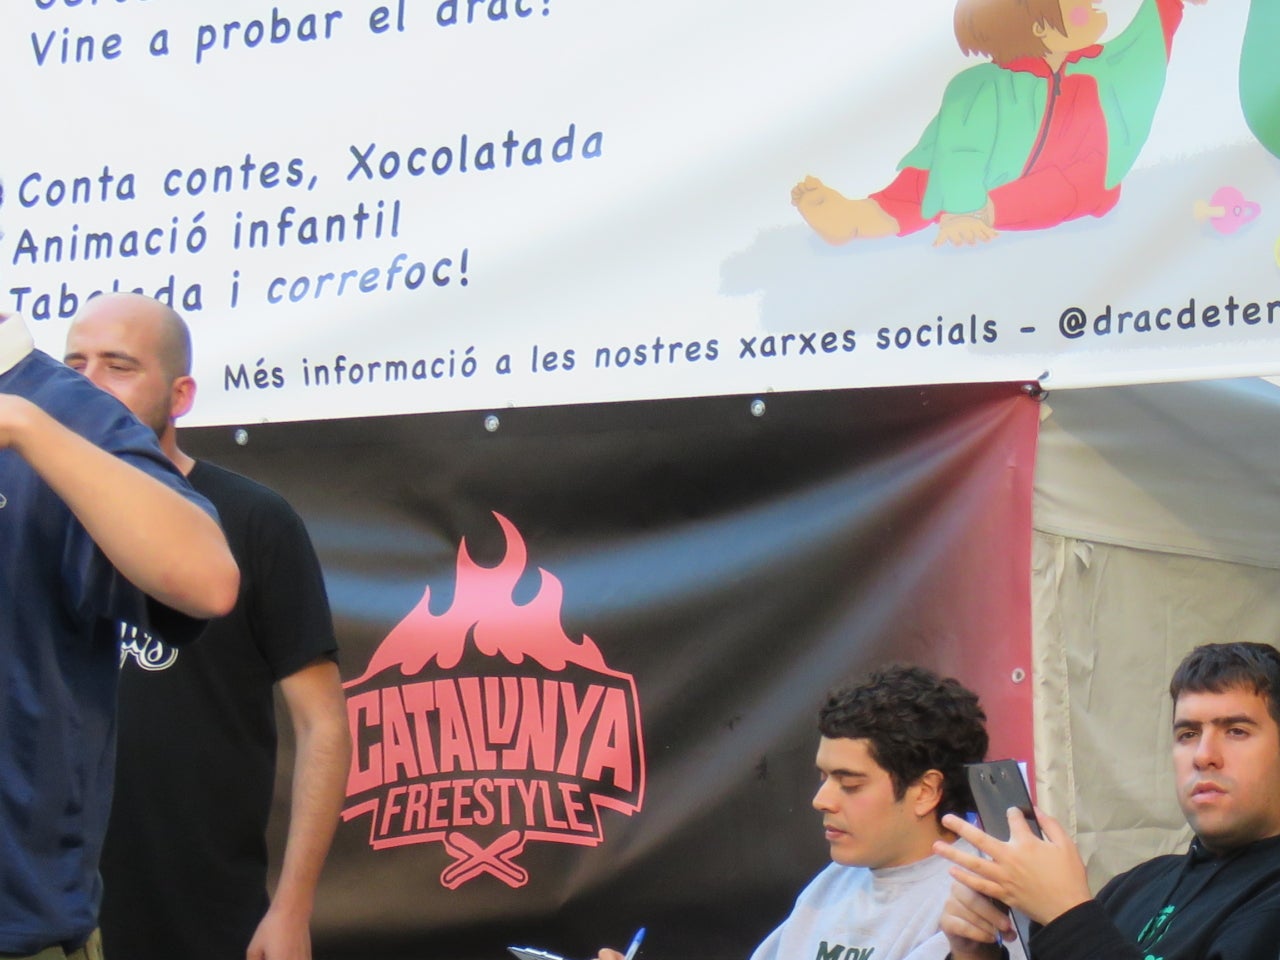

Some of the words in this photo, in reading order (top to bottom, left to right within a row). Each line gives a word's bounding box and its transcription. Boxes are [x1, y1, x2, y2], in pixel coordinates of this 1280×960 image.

[31, 26, 122, 67] Vine
[149, 28, 170, 57] a
[196, 6, 344, 65] probar
[369, 0, 406, 33] el
[18, 165, 137, 209] Conta
[163, 153, 318, 193] contes,
[346, 122, 605, 182] Xocolatada
[12, 210, 207, 265] Animació
[233, 200, 402, 251] infantil
[9, 274, 203, 321] Tabda
[231, 270, 240, 309] i
[267, 248, 470, 306] correfoc!
[224, 357, 286, 392] Més
[303, 345, 477, 387] informació
[495, 353, 512, 375] a
[531, 344, 576, 374] les
[595, 336, 719, 369] nostres
[738, 329, 857, 360] xarxes
[876, 313, 998, 351] socials
[345, 676, 634, 797] CATALUNYA
[379, 777, 595, 837] FREESTYLE
